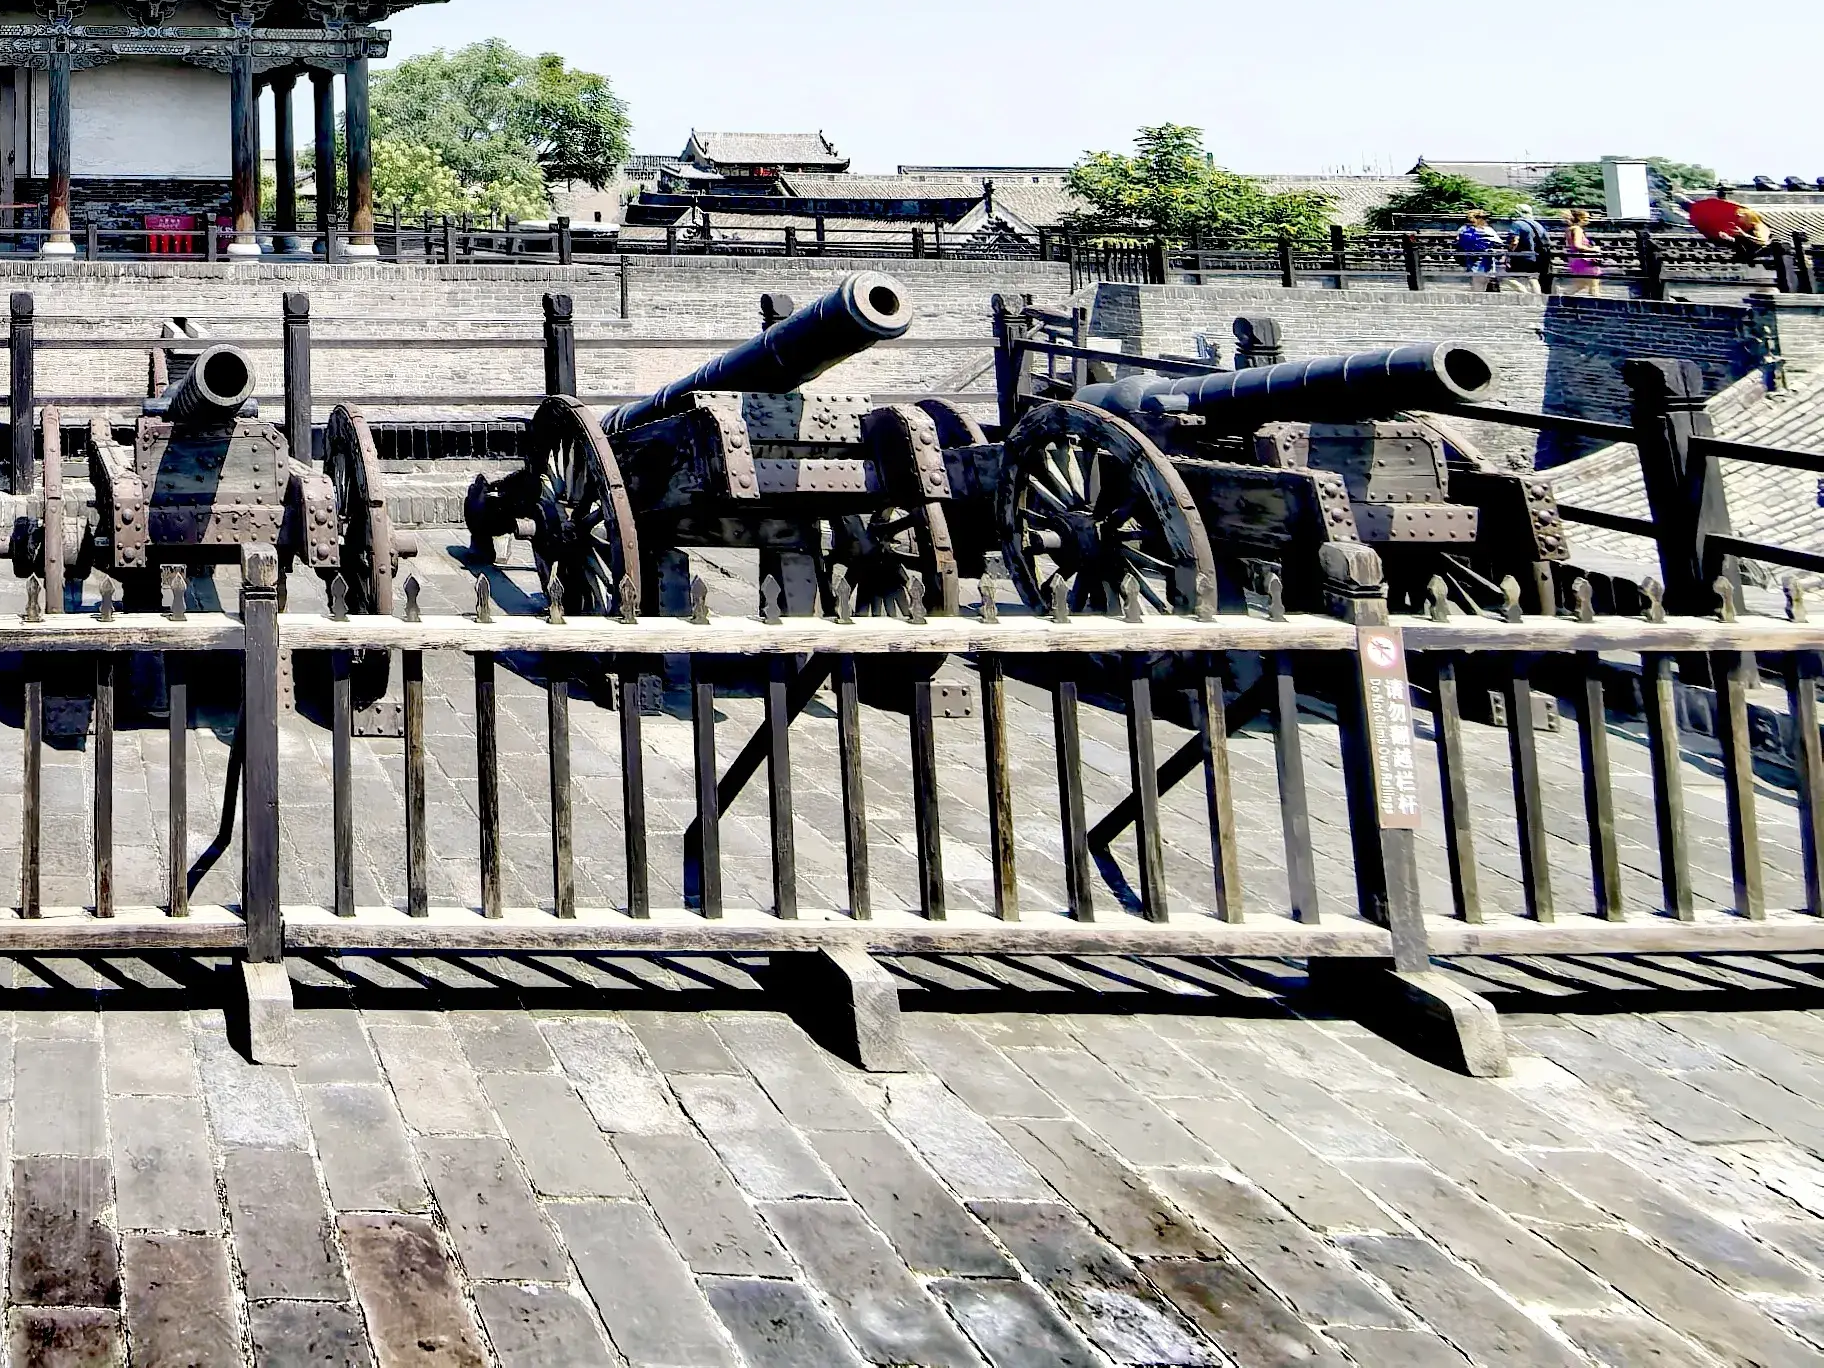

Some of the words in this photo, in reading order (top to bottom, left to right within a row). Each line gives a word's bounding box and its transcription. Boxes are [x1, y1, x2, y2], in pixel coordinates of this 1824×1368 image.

[1369, 678, 1382, 692] Do
[1370, 693, 1384, 714] Not
[1372, 715, 1388, 745] Climb
[1377, 746, 1391, 772] Over
[1384, 678, 1419, 815] 请勿翻越栏杆
